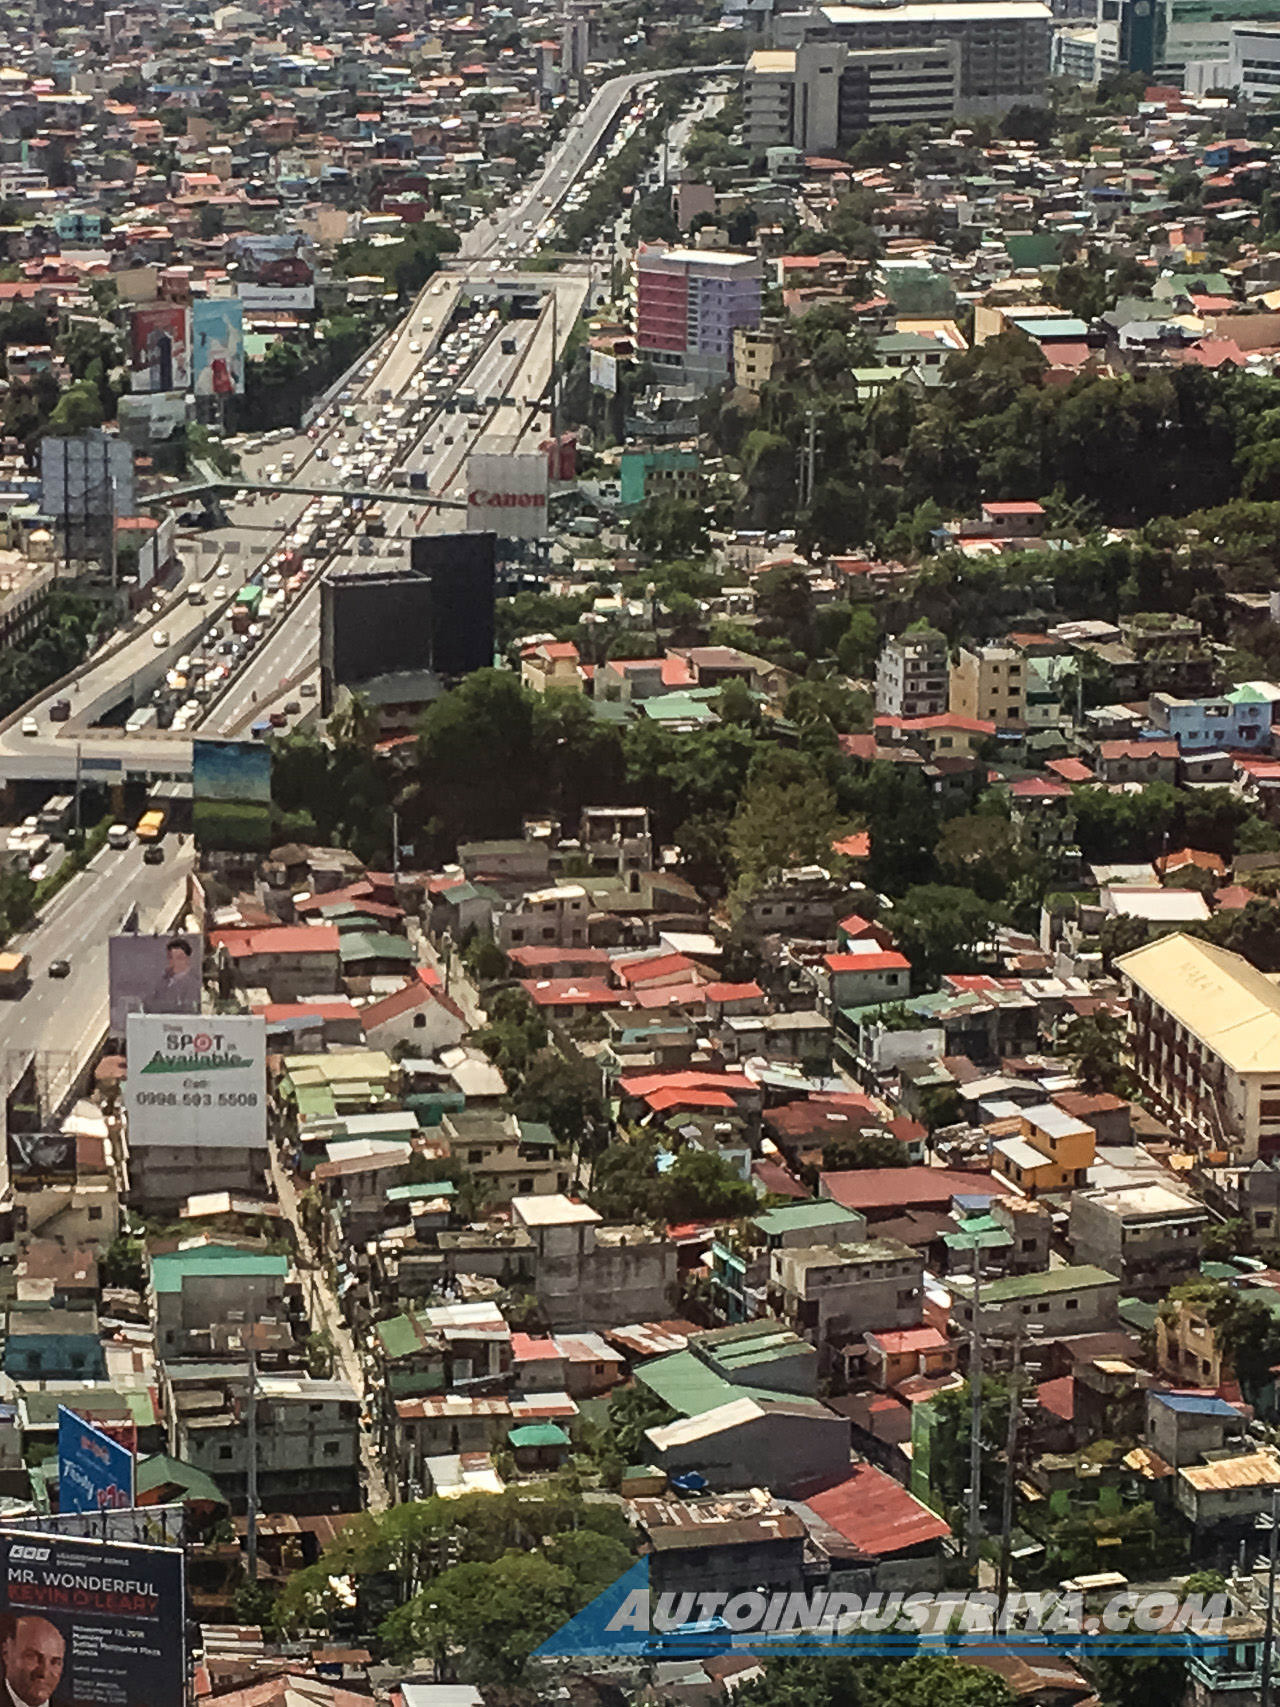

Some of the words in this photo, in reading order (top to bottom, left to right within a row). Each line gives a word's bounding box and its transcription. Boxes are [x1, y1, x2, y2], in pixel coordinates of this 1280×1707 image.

[468, 489, 545, 508] Canon
[166, 1033, 224, 1052] SPOT
[150, 1050, 242, 1069] Available
[7, 1567, 39, 1585] MR.
[42, 1571, 160, 1598] WONDERFUL
[7, 1584, 66, 1605] KEVIN
